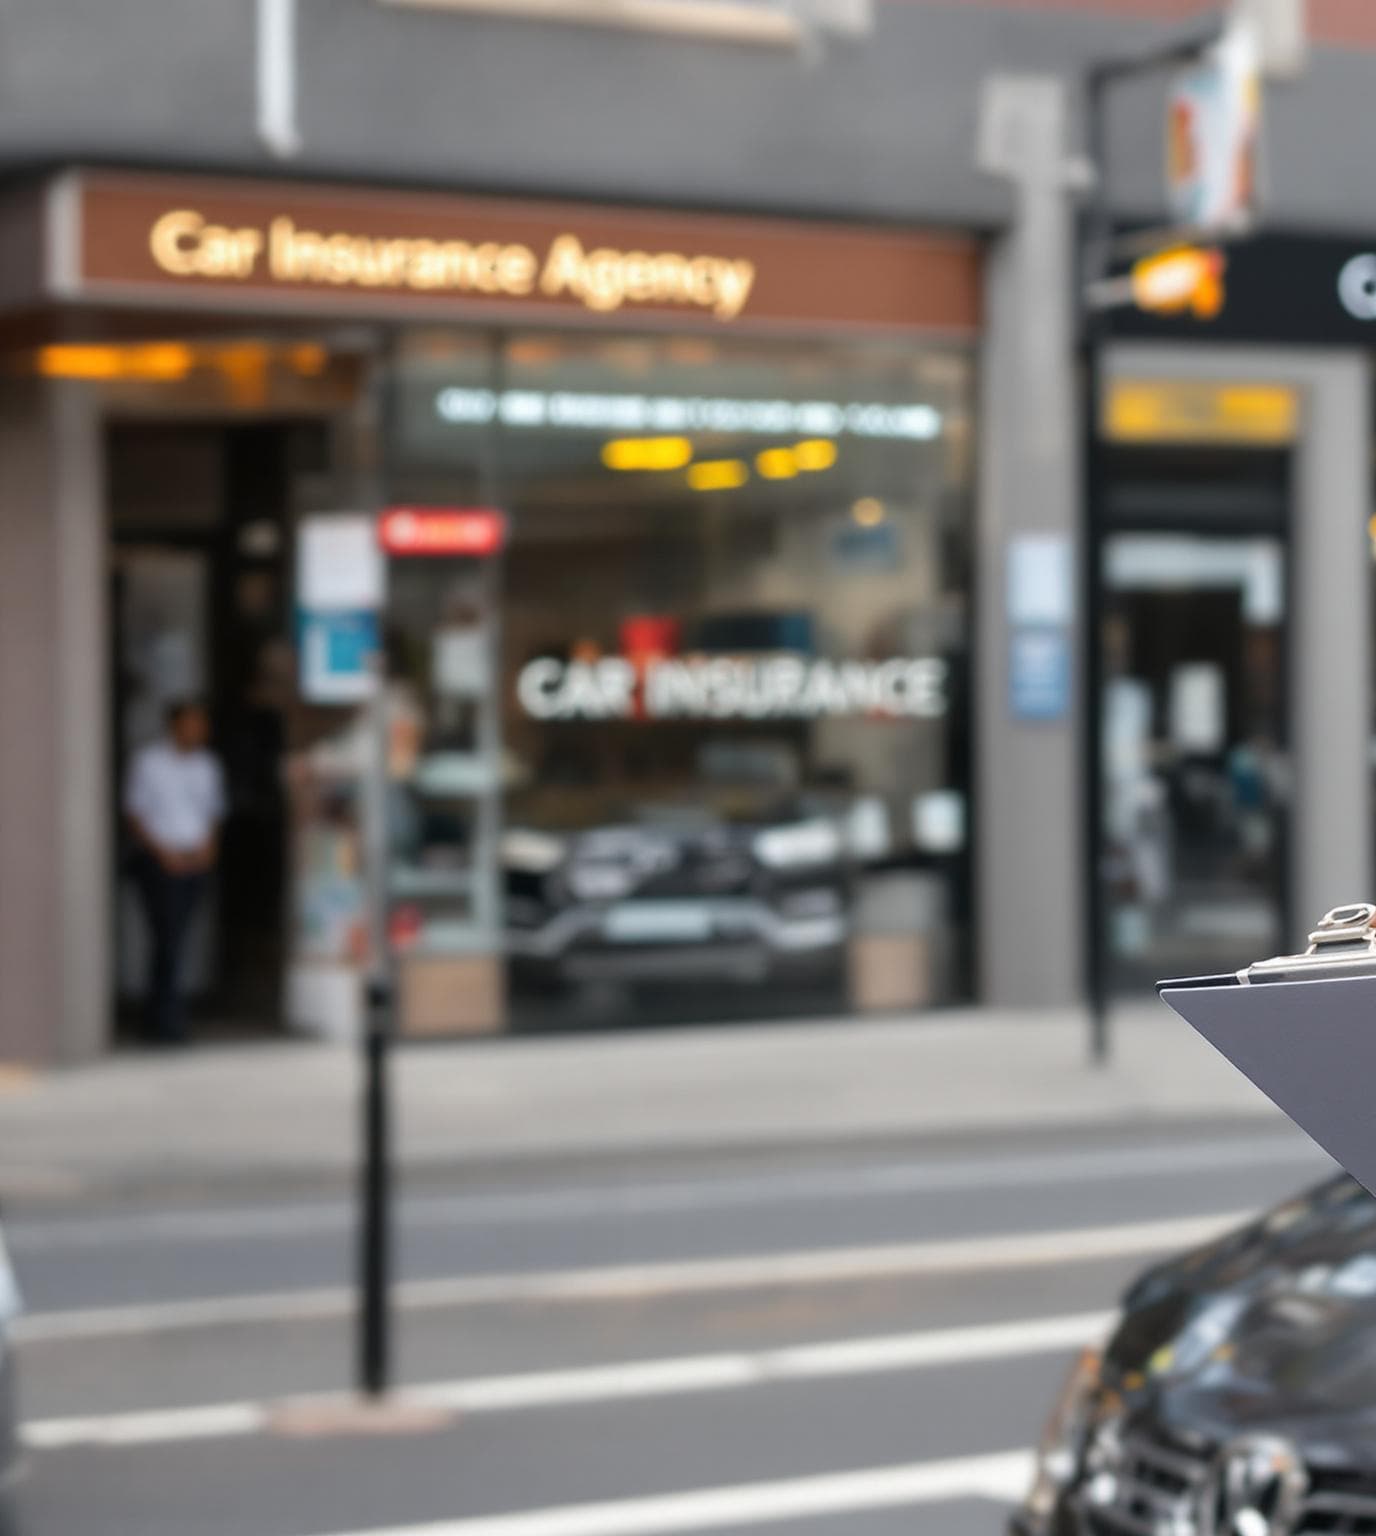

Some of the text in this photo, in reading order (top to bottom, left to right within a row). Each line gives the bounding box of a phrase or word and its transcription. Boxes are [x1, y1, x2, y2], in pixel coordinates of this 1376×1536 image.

[151, 209, 755, 322] Car Insurance Agency
[517, 655, 945, 719] CAR INSURANCE
